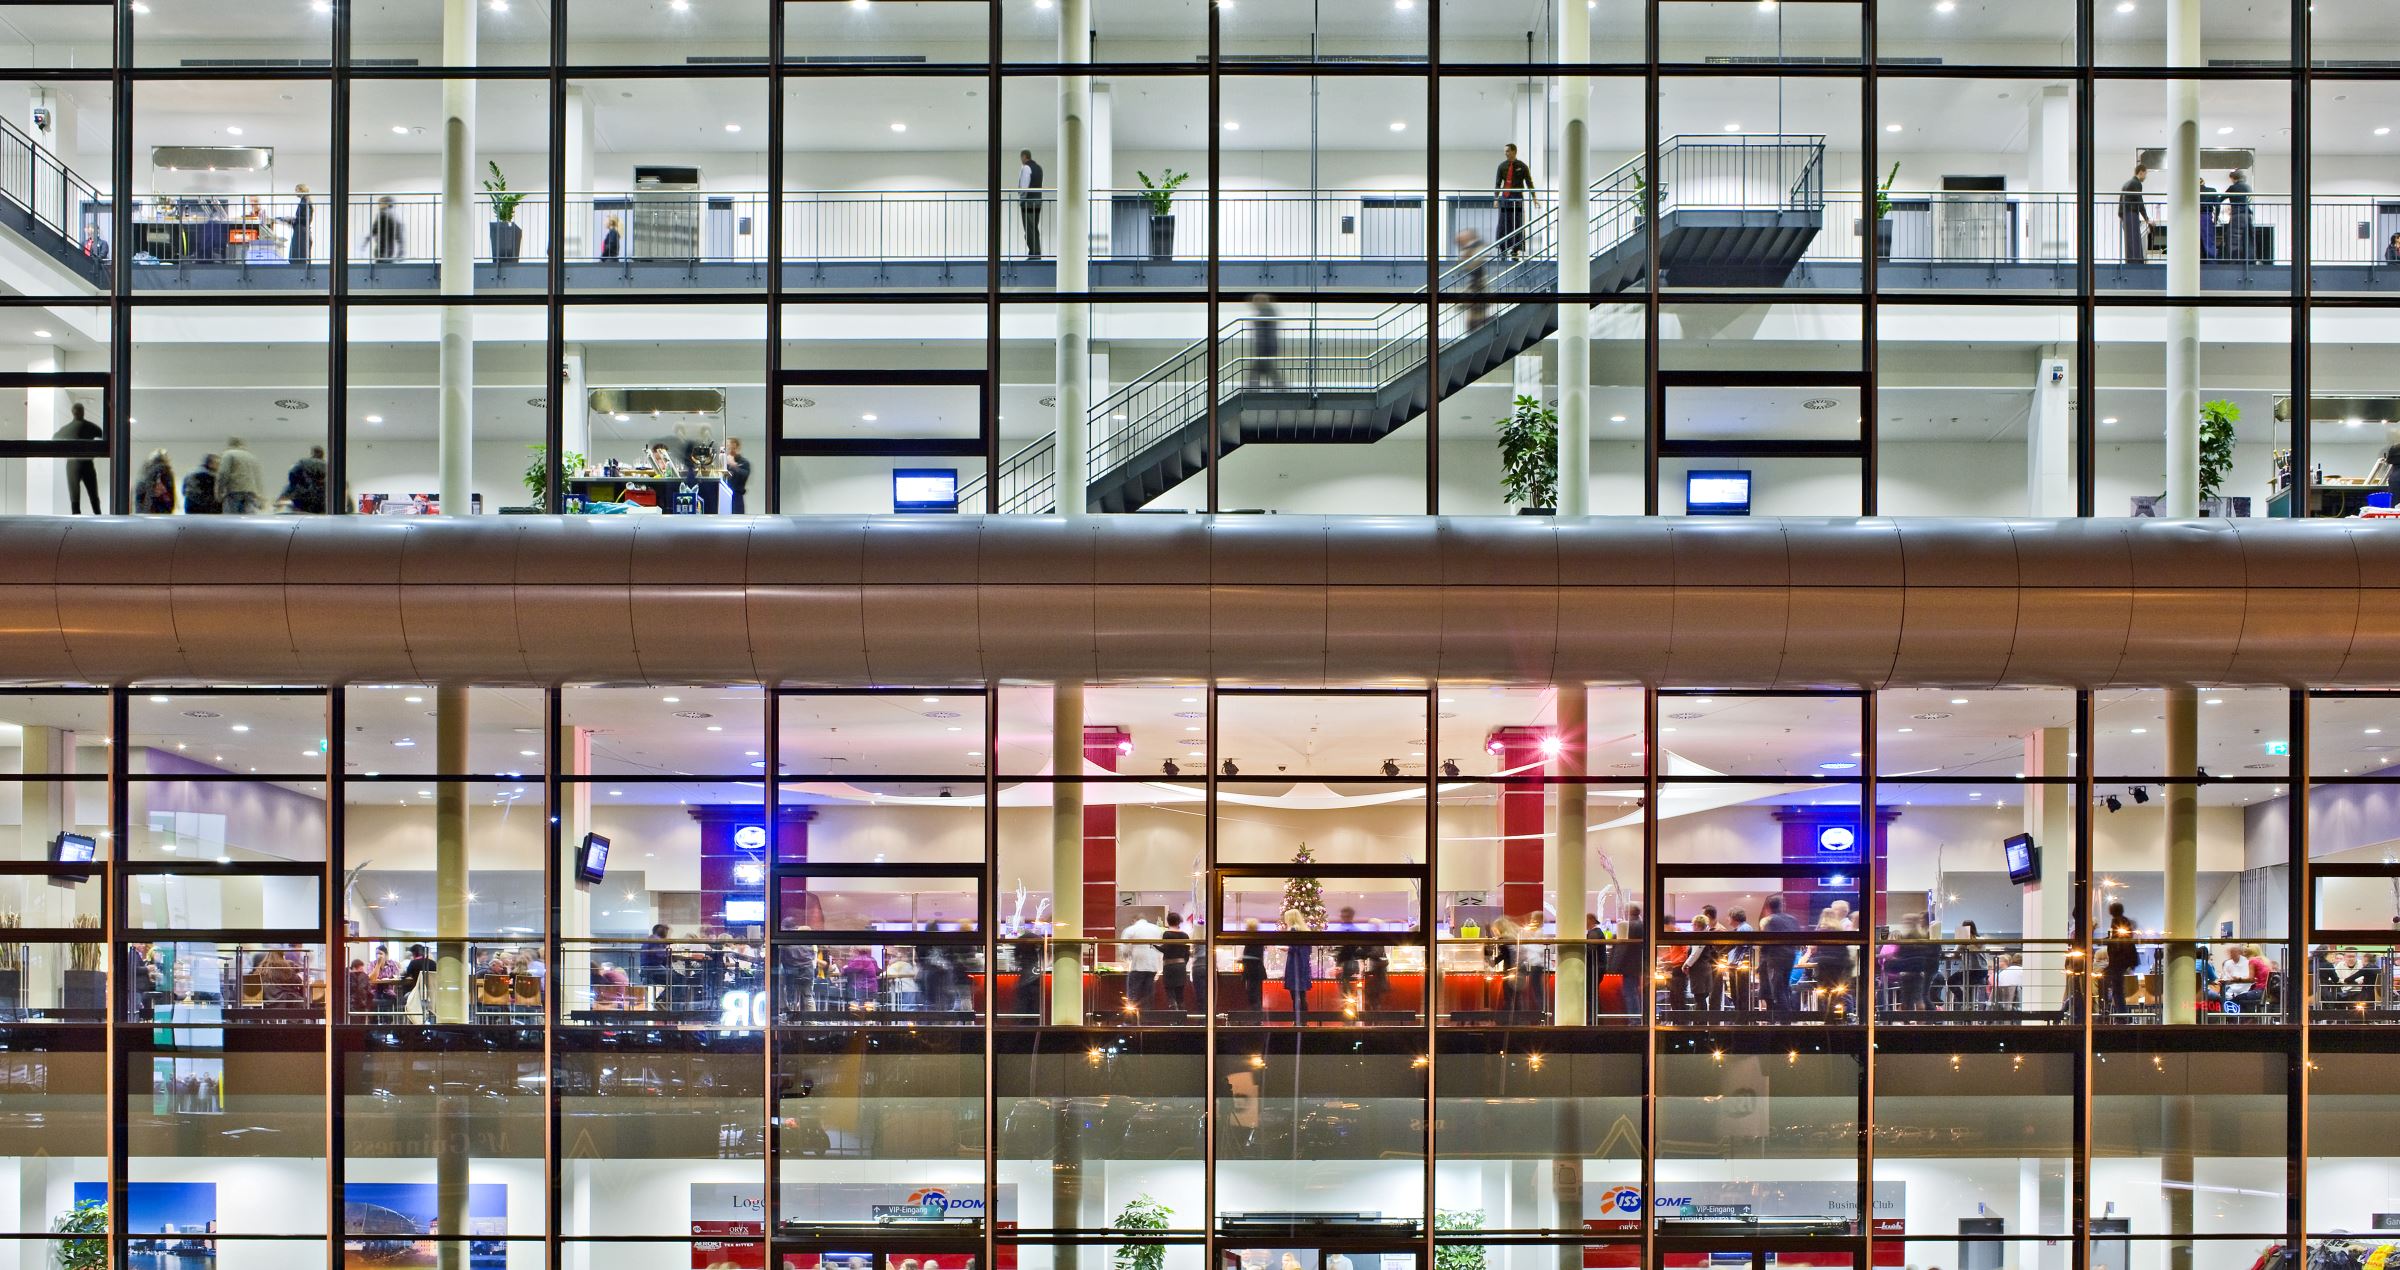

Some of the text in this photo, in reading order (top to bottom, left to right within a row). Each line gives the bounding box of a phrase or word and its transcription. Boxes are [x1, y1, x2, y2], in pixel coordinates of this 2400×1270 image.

[950, 1199, 998, 1209] DOM
[1618, 1195, 1692, 1207] ISS OME
[1828, 1200, 1894, 1210] Busin Club
[888, 1205, 928, 1215] VIP-Eingang
[1696, 1205, 1735, 1214] VIP-Eingang
